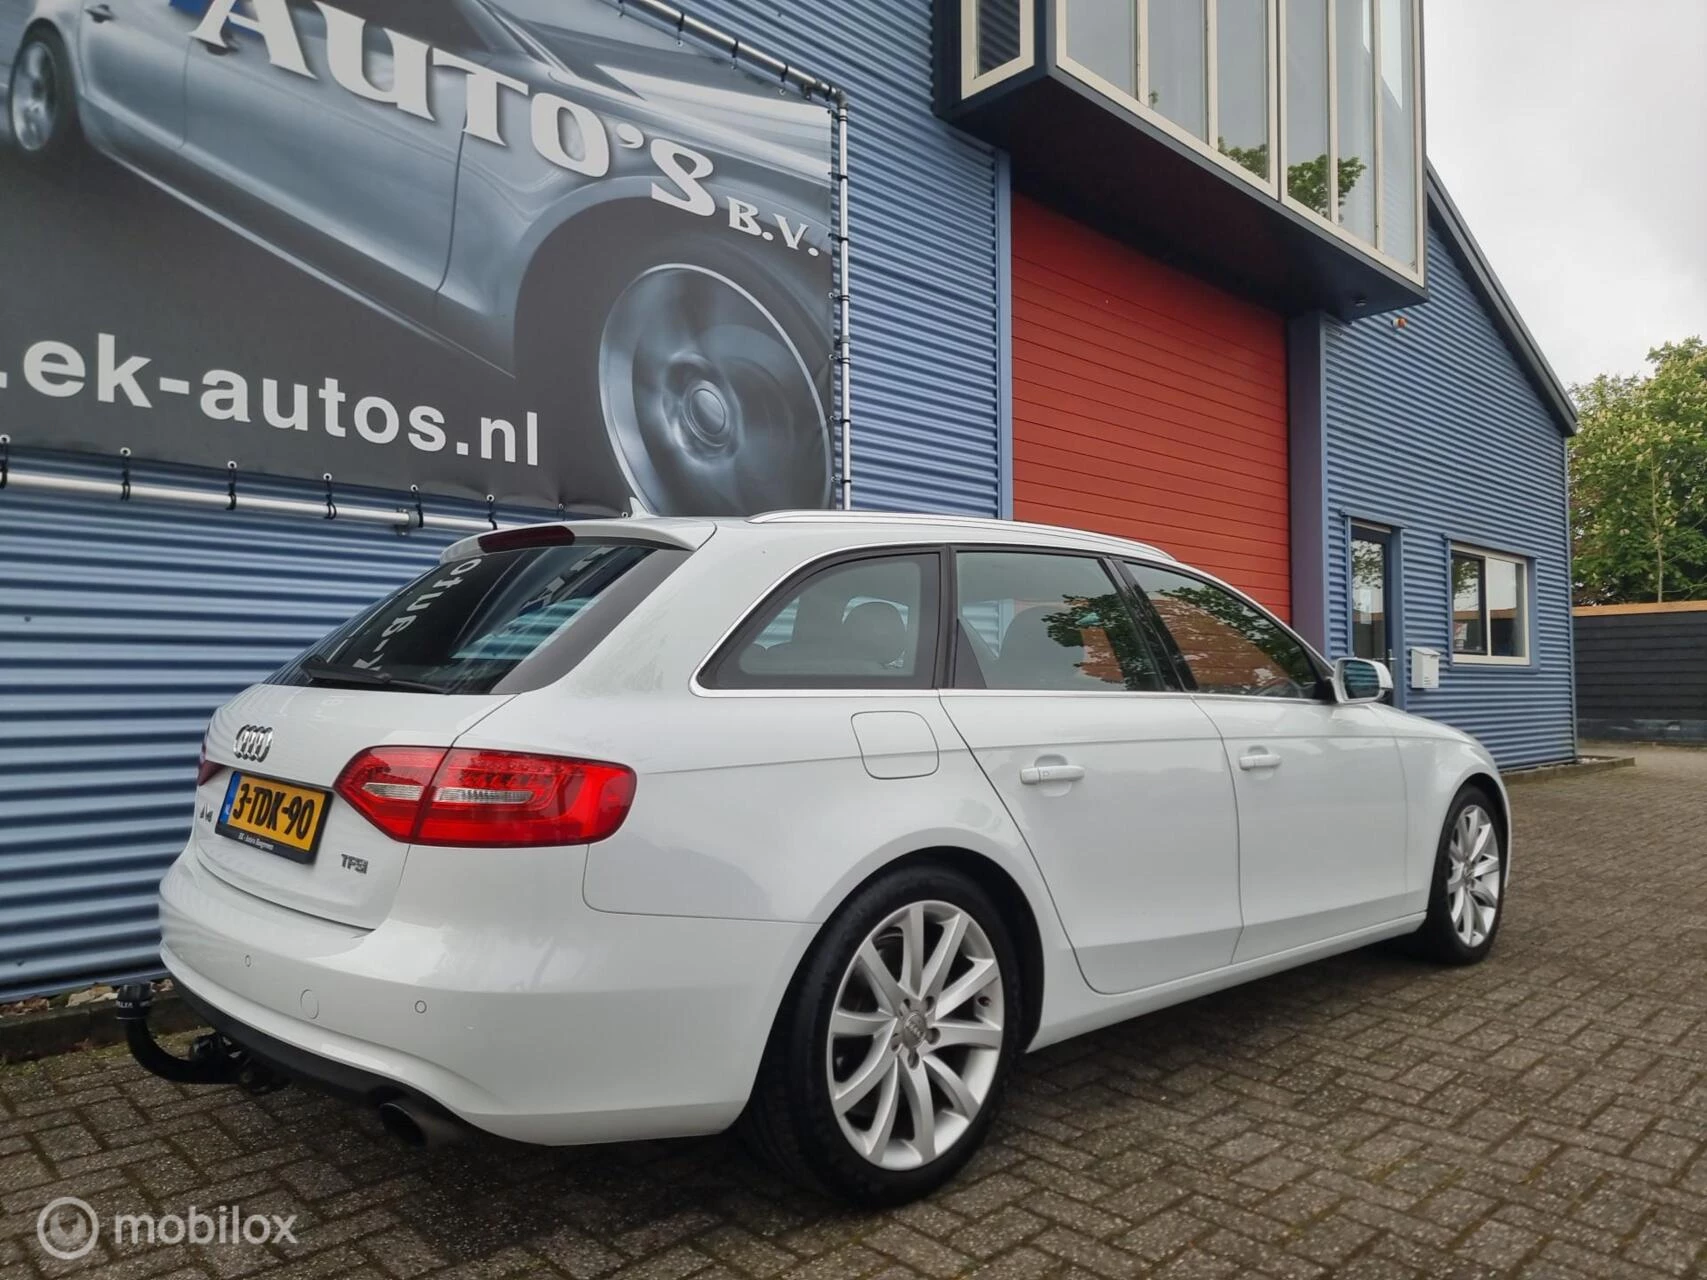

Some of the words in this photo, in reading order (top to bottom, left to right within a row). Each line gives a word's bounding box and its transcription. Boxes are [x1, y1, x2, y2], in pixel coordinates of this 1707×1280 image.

[727, 196, 820, 257] B.V.
[232, 783, 315, 840] 3-TDK-90
[340, 853, 369, 875] TFSI
